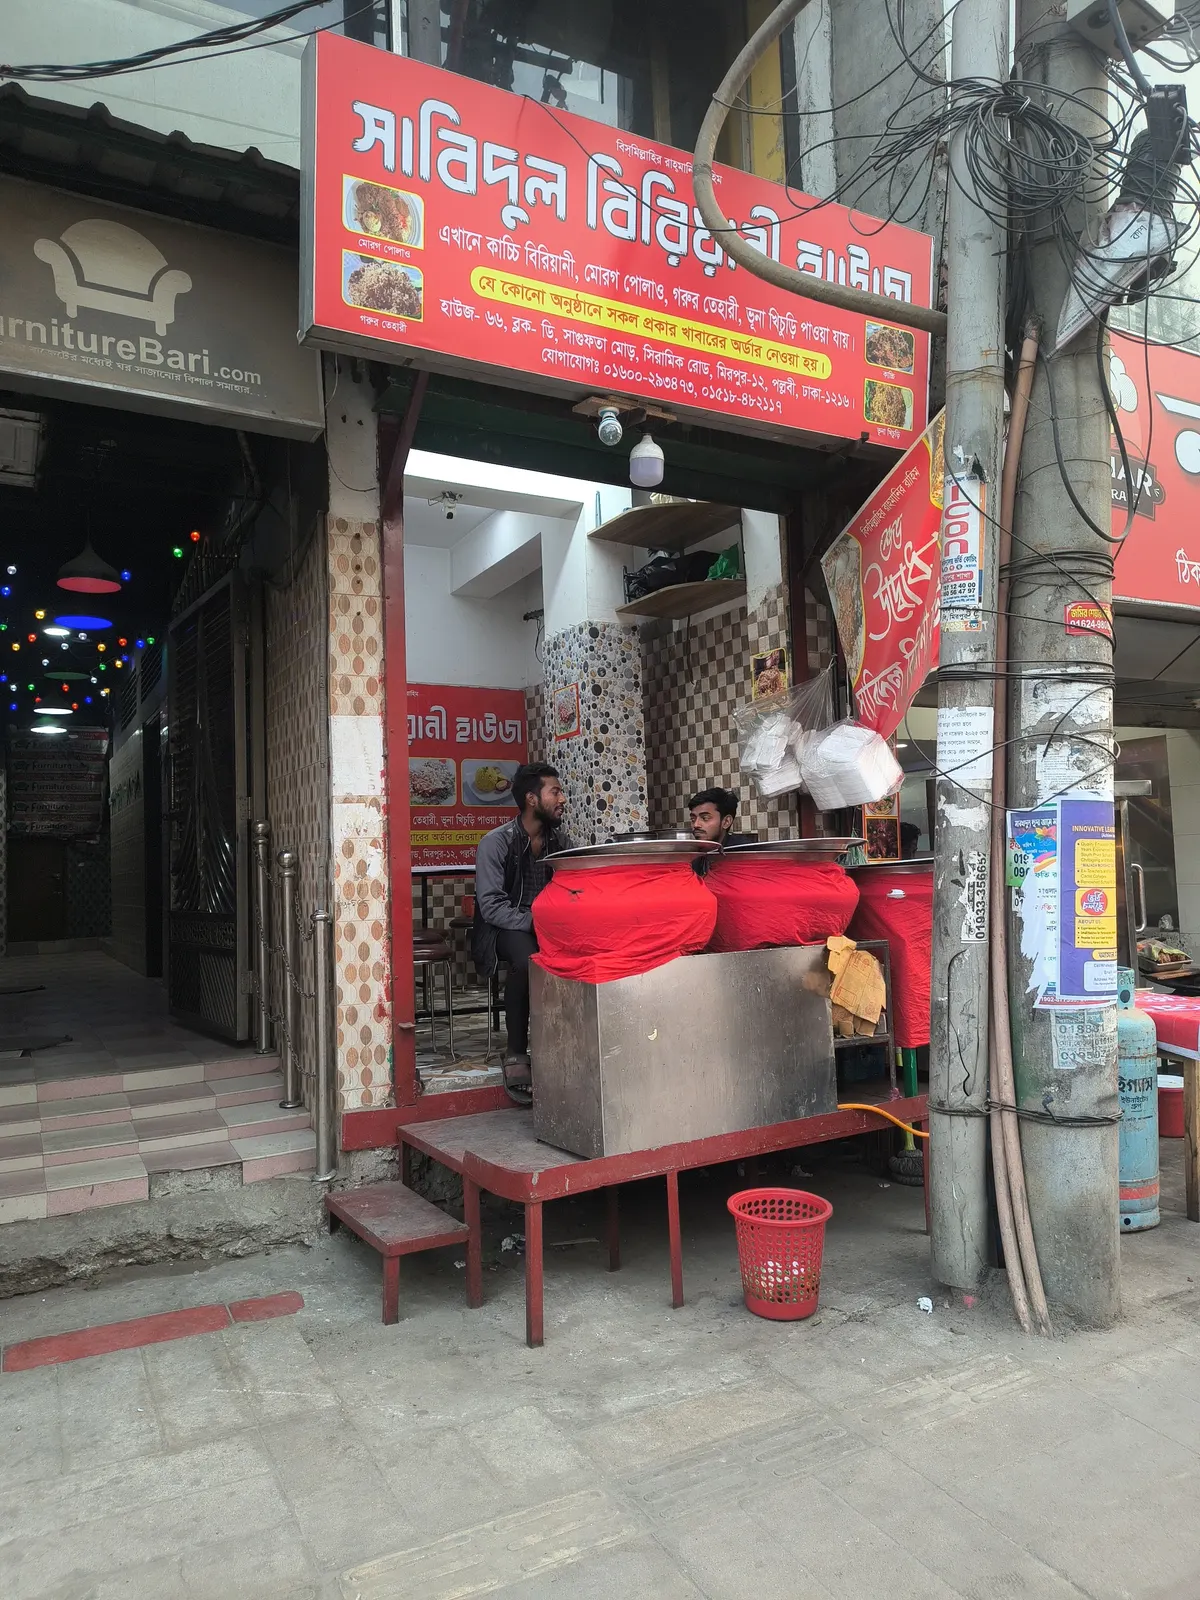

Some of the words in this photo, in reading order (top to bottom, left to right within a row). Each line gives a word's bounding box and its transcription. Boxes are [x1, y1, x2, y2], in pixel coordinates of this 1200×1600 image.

[352, 98, 567, 231] সাবিদুল
[358, 238, 381, 251] মোরগ
[384, 245, 411, 258] পোলাও
[439, 225, 482, 254] এখানে
[485, 234, 521, 262] কাচ্চি
[524, 240, 579, 283] বিরিয়ানী,
[584, 263, 620, 290] মোরগ
[624, 274, 668, 307] পোলাও,
[672, 286, 700, 311] গরুর
[703, 295, 742, 327] তেহারী,
[745, 306, 766, 332] ভূনা
[768, 307, 797, 339] খিচুড়ি
[800, 321, 829, 345] পাওয়া
[479, 275, 496, 292] যে
[500, 280, 546, 305] কোনো
[549, 292, 603, 317] অনুষ্ঠানে
[606, 306, 639, 328] সকল
[643, 316, 678, 338] প্রকার
[681, 326, 728, 351] খাবারের
[731, 337, 762, 359] অর্ডার
[766, 348, 800, 369] নেওয়া
[183, 372, 213, 387] বিশাল
[562, 328, 608, 352] সাগুফতা
[611, 340, 639, 362] মোড়,
[643, 343, 685, 370] সিরামিক
[687, 358, 713, 380] রোড,
[456, 712, 522, 744] হাউজ
